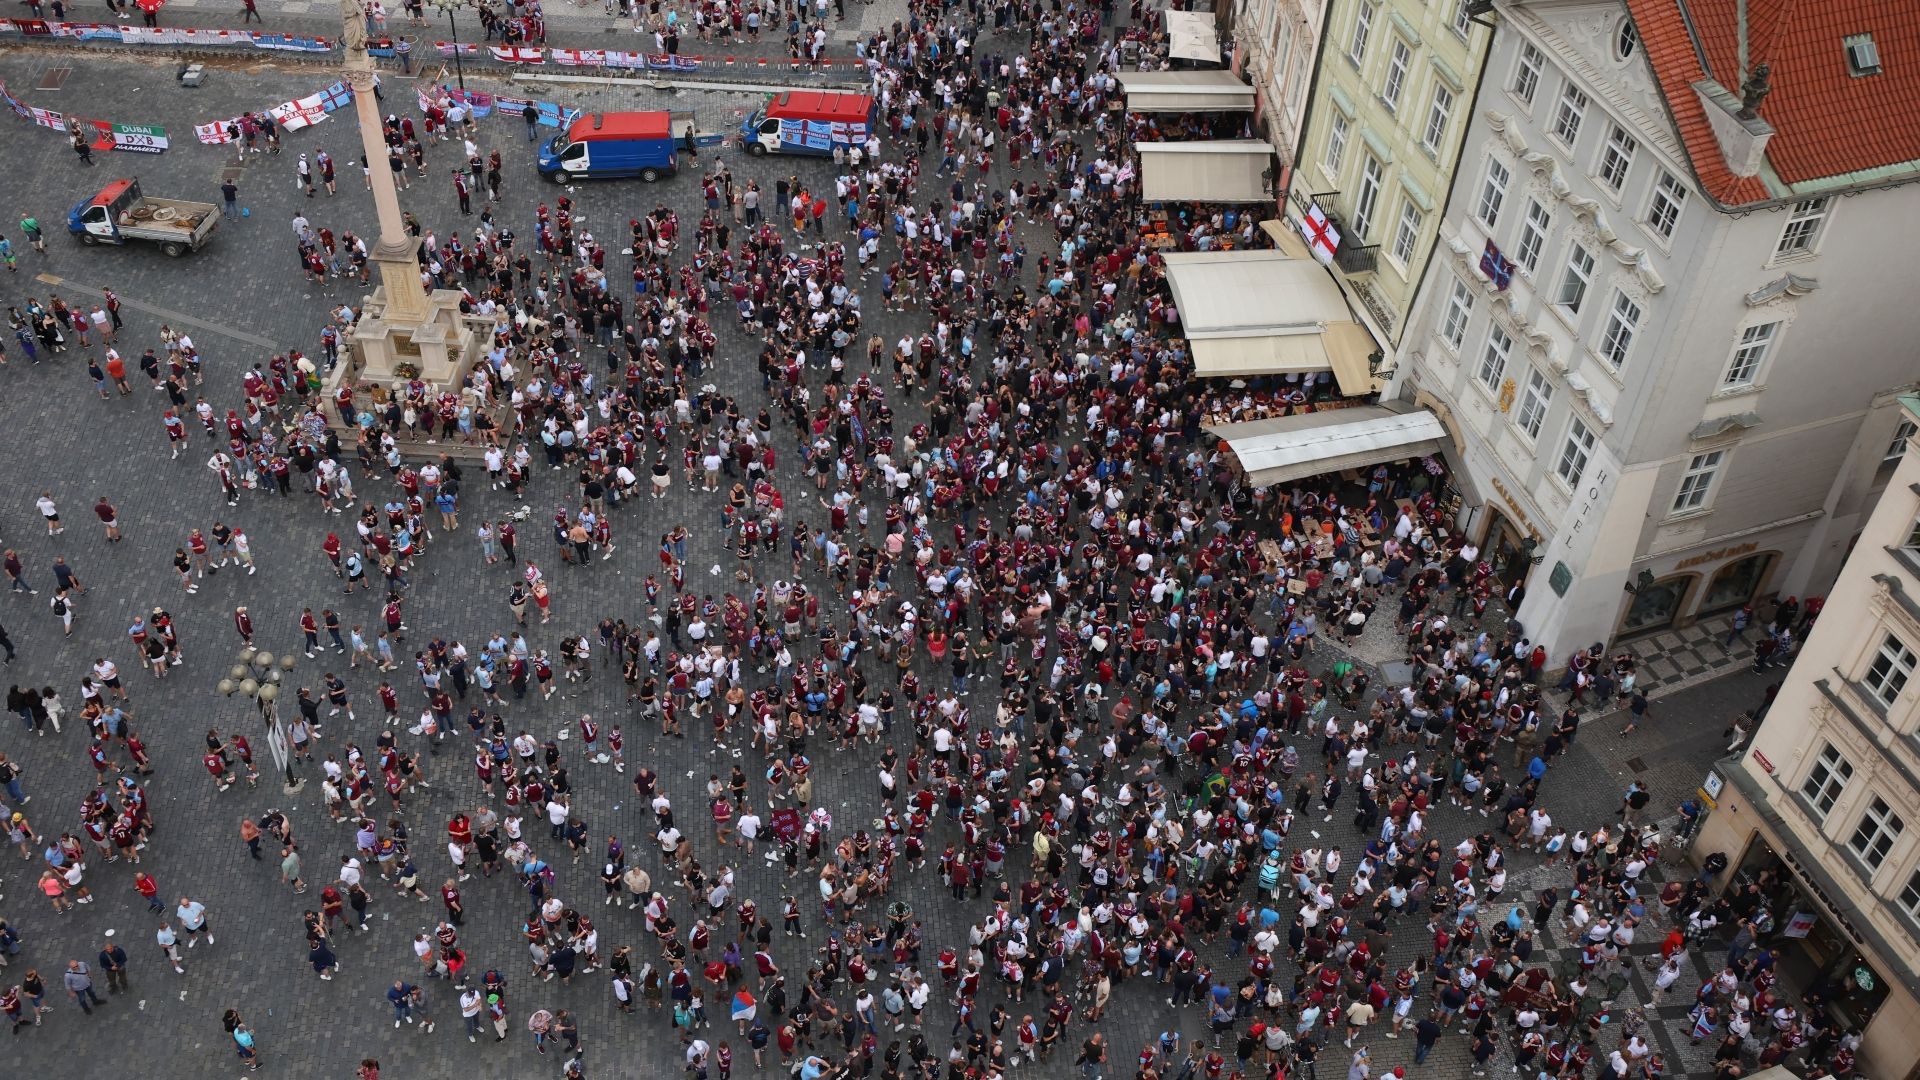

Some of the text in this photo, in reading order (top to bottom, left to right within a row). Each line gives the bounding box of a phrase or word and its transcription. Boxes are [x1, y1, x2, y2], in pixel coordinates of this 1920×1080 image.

[121, 125, 152, 134] DUBAI
[114, 144, 161, 153] HAMMERS
[1565, 470, 1607, 549] HOTEL
